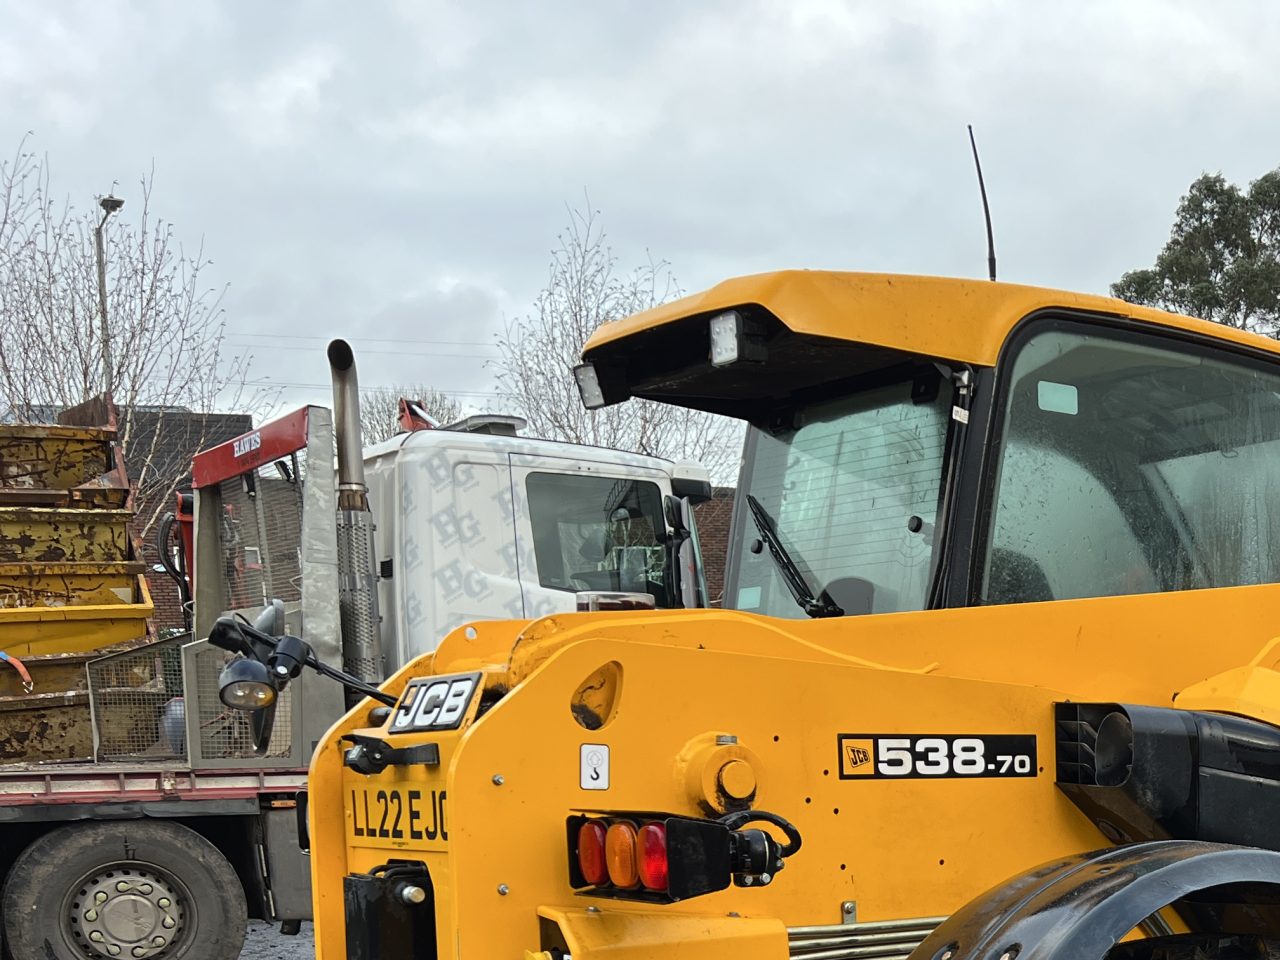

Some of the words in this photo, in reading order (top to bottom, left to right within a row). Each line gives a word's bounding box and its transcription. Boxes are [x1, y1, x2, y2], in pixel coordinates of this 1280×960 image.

[233, 431, 261, 458] HAWES
[395, 679, 473, 727] JCB
[850, 748, 870, 767] JCB
[351, 790, 403, 839] LL22
